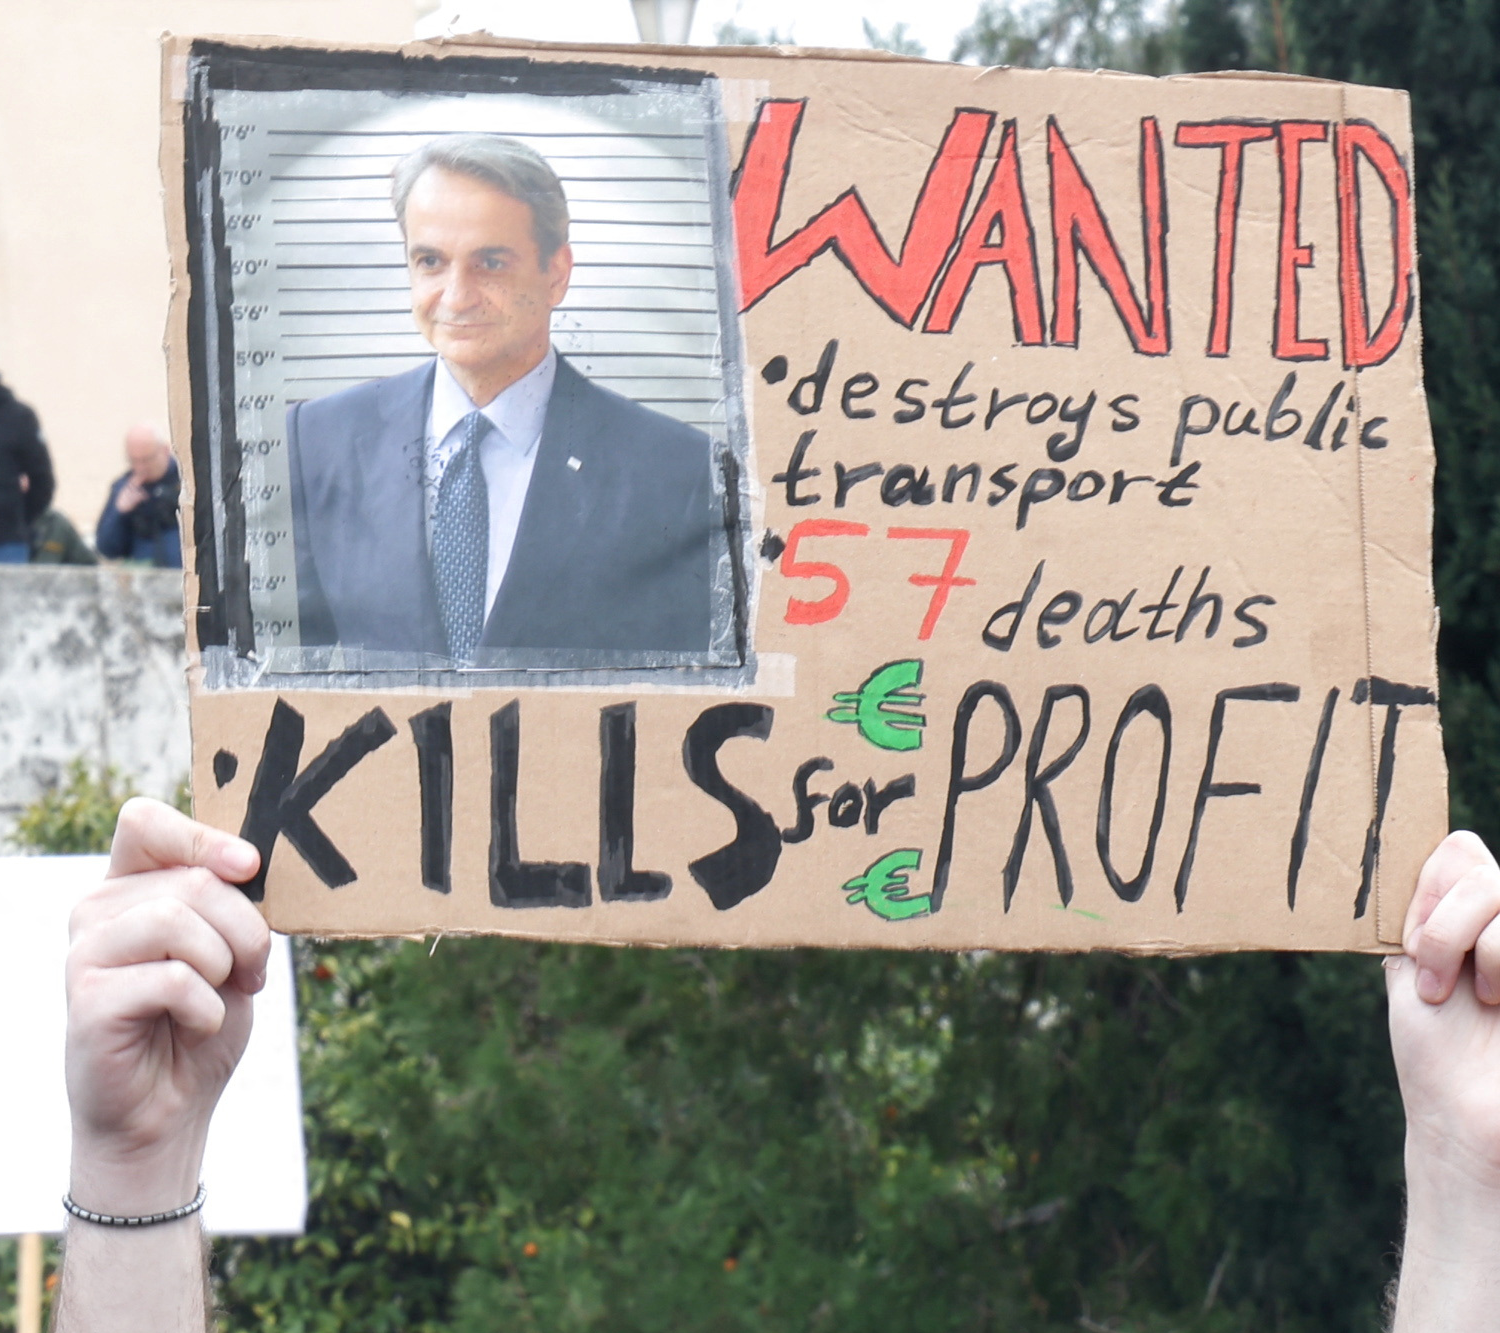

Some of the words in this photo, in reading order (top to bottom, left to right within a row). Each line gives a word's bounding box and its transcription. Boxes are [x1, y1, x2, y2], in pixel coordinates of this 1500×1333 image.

[730, 97, 1414, 371] WANTED
[787, 338, 1141, 462] destroys
[1170, 372, 1389, 467] public
[772, 430, 1203, 532] transport
[780, 518, 977, 642] 57
[981, 559, 1277, 652] deaths
[238, 695, 782, 911] KILLS
[782, 757, 916, 843] for
[930, 677, 1438, 921] PROFIT
